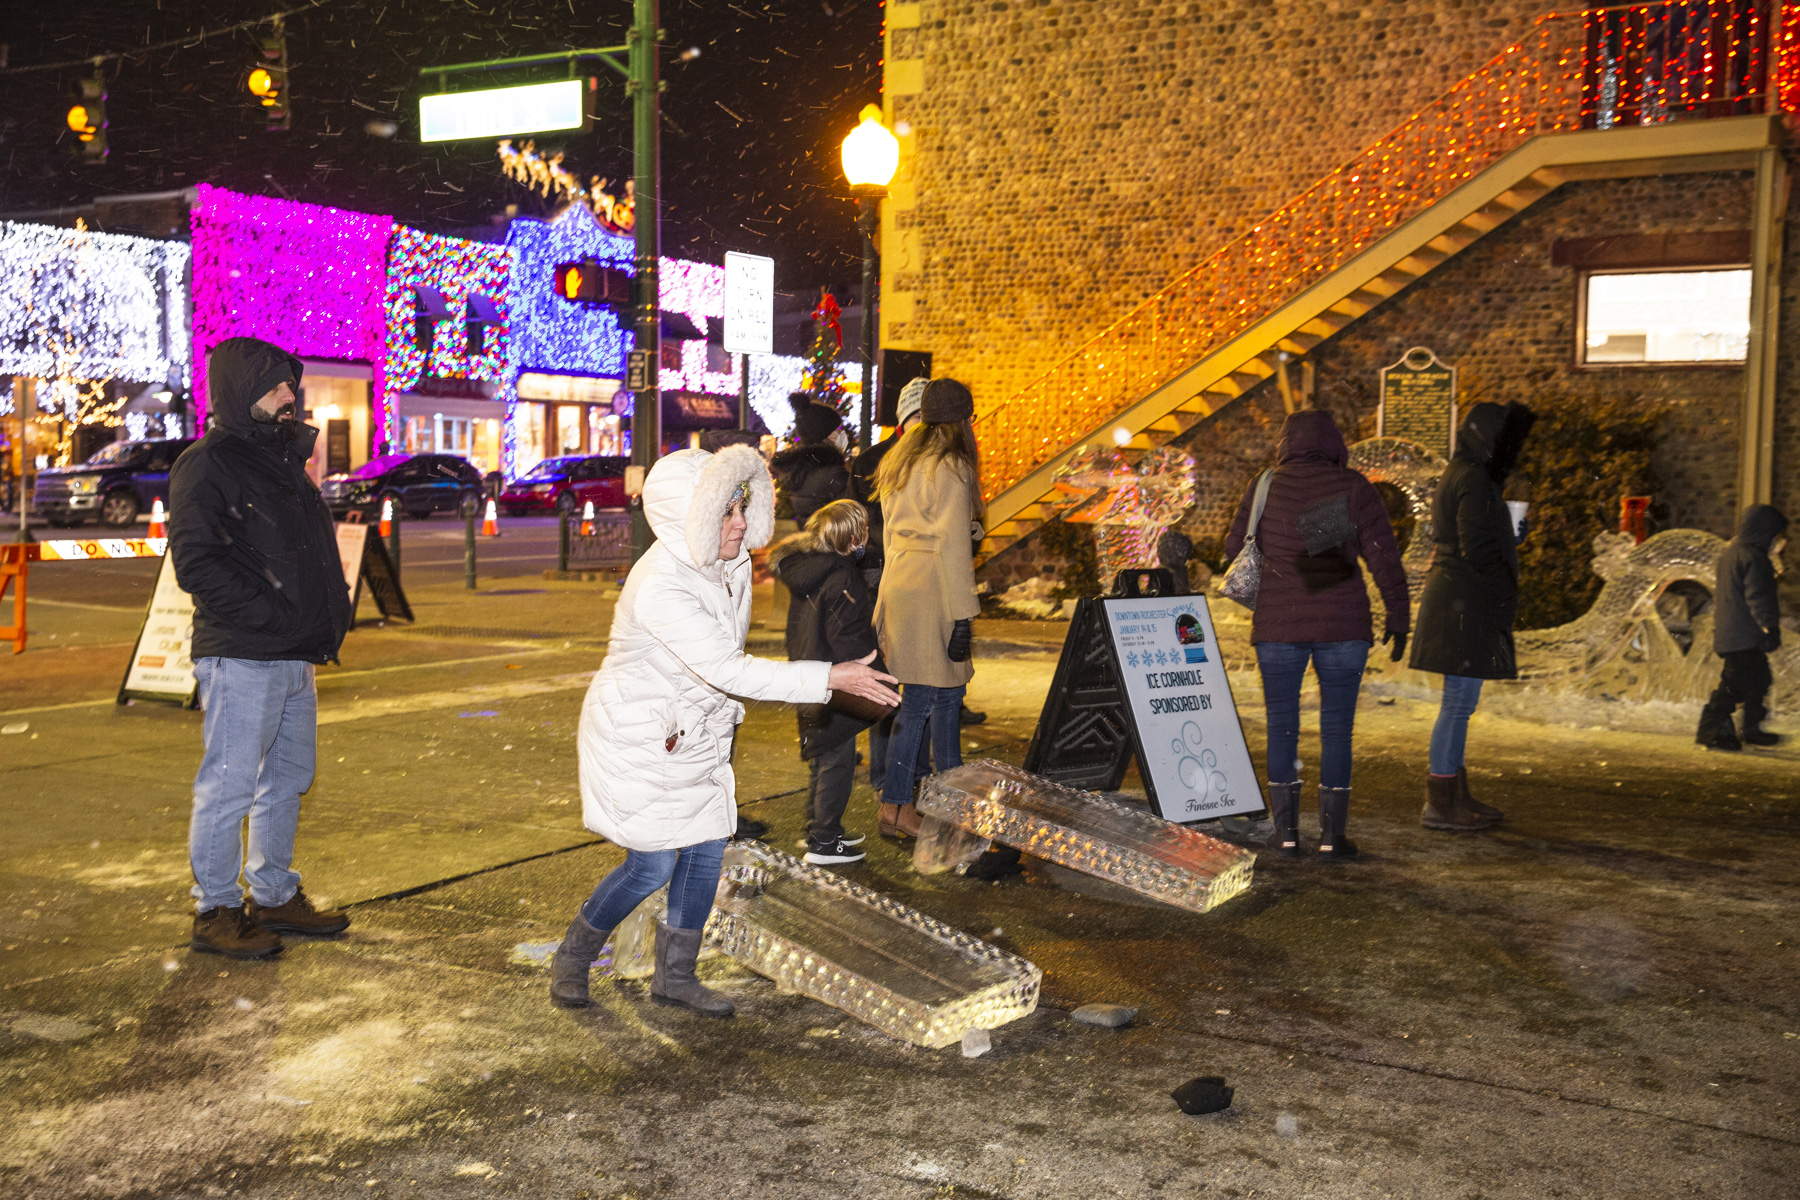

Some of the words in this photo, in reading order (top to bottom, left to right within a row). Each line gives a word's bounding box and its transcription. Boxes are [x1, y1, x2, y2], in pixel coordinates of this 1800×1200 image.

[742, 266, 757, 280] NO
[737, 286, 763, 301] TURN
[730, 307, 744, 320] ON
[749, 309, 768, 324] RED
[72, 543, 97, 556] DO
[111, 542, 145, 554] NOT
[1115, 611, 1140, 621] DOWNTOWN
[1140, 609, 1167, 619] ROCHESTER
[1119, 624, 1140, 634] JANUARY
[1146, 673, 1161, 689] ICE
[1160, 670, 1204, 688] CORNHOLE
[1150, 695, 1200, 714] SPONSORED
[1199, 694, 1212, 709] BY
[1185, 799, 1219, 812] Finesse
[1220, 794, 1236, 807] Ice
